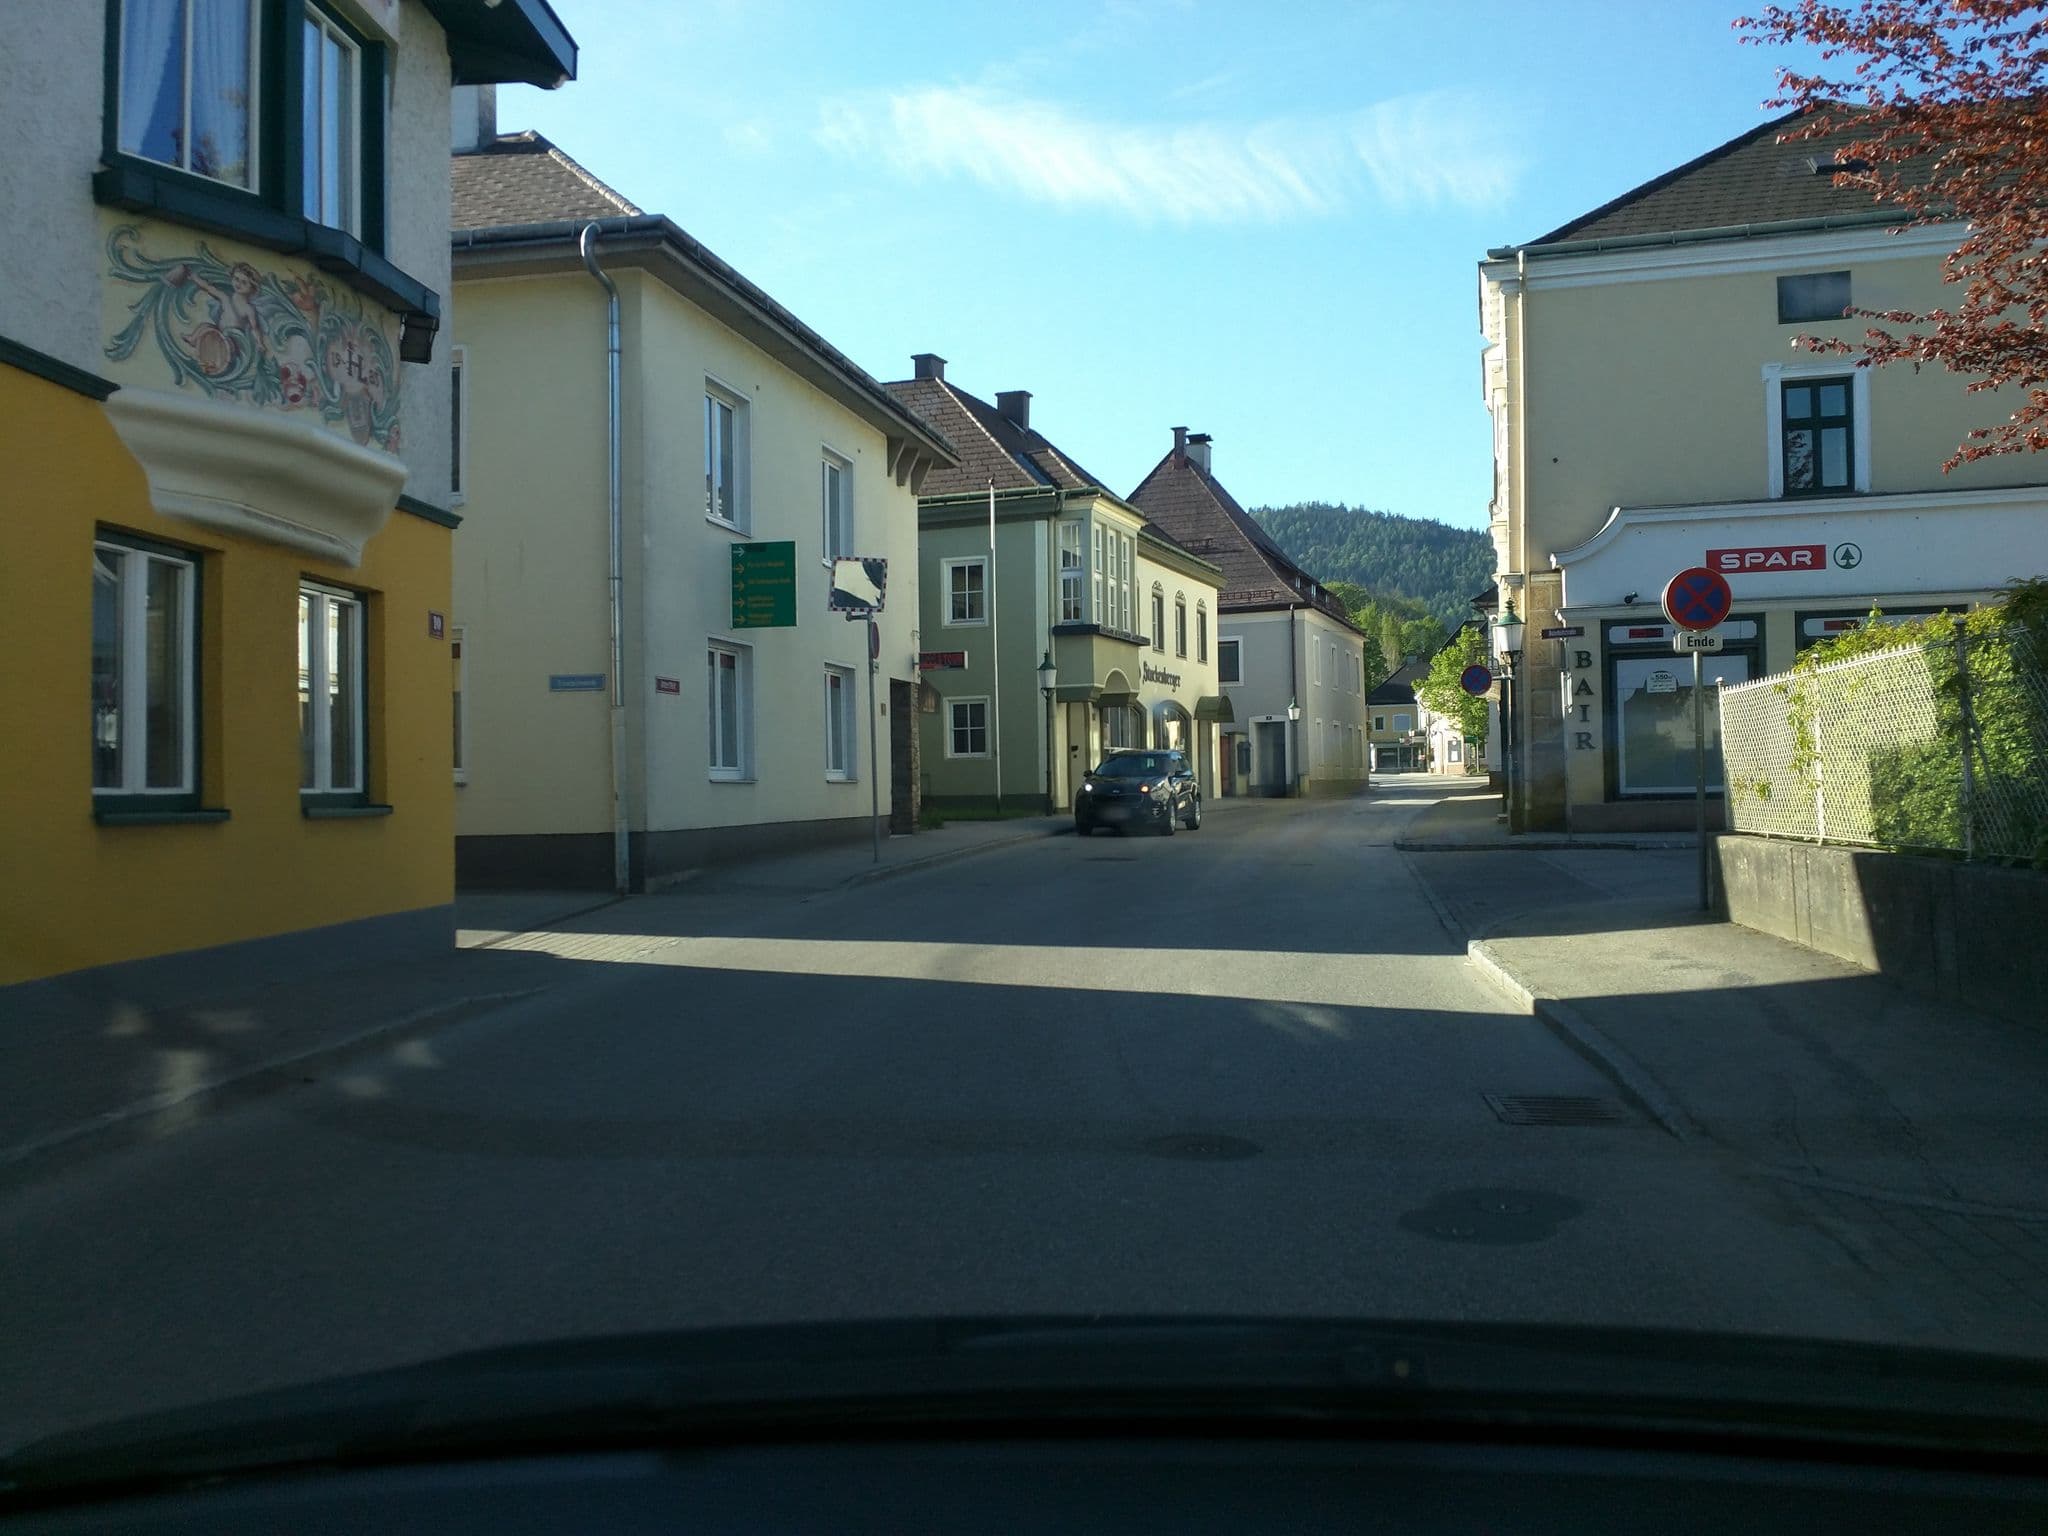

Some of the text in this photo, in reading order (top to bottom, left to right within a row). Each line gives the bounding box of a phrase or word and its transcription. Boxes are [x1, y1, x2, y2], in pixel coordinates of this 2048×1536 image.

[1720, 550, 1813, 569] SPAR
[1687, 636, 1715, 647] Ende
[1574, 650, 1596, 750] BAIR
